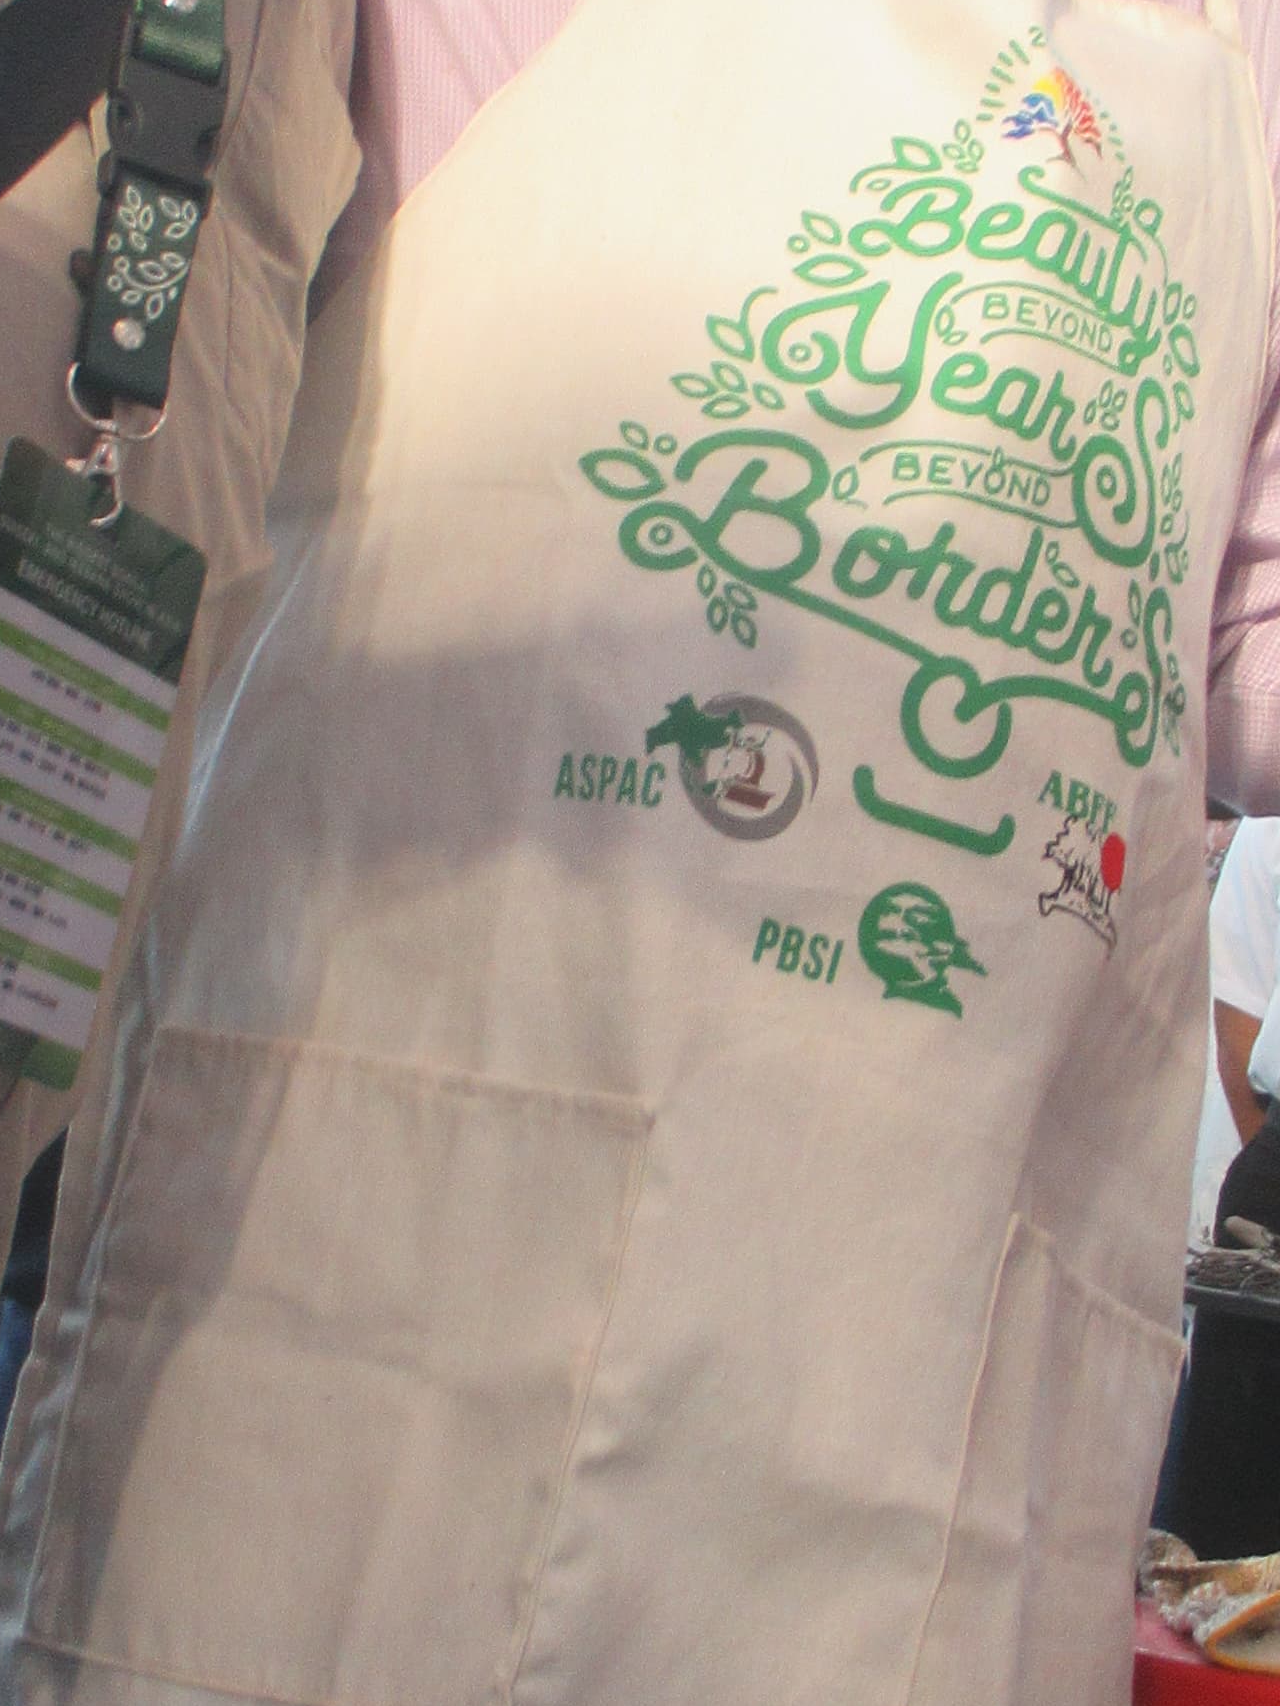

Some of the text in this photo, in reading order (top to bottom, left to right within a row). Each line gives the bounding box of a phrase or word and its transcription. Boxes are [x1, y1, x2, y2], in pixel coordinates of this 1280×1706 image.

[848, 165, 1162, 377] Beauty
[981, 291, 1114, 354] BEYOND
[891, 448, 1051, 509] BEYOND
[554, 752, 667, 809] ASPAC
[752, 917, 844, 984] PBSI
